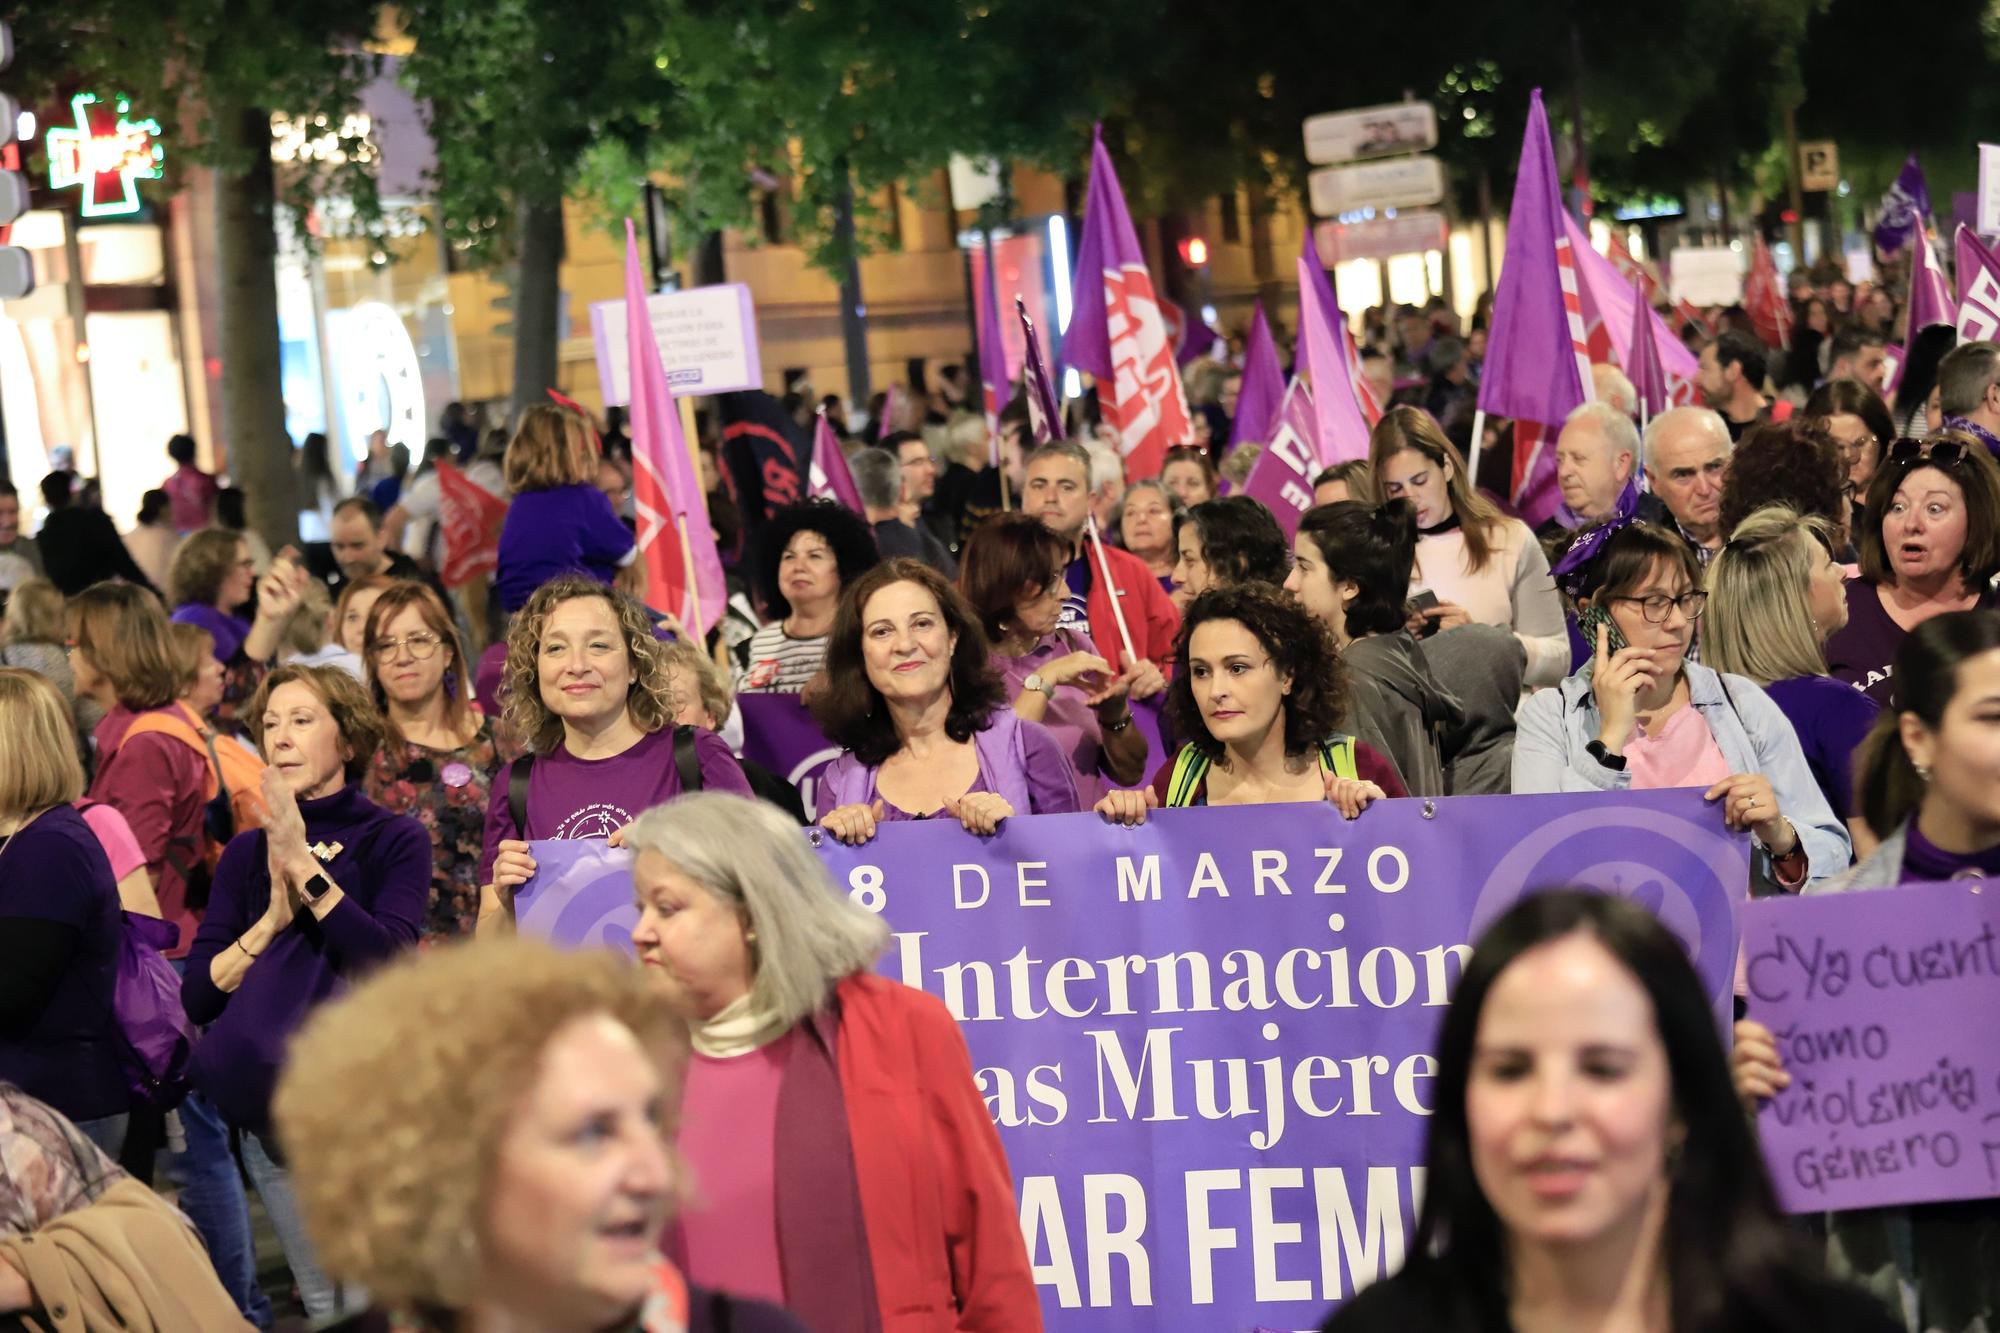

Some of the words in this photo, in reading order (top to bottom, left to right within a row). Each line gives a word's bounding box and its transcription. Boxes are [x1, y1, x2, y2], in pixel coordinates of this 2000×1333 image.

[849, 864, 887, 914] 8
[952, 861, 1051, 909] DE
[1115, 845, 1410, 902] MARZO
